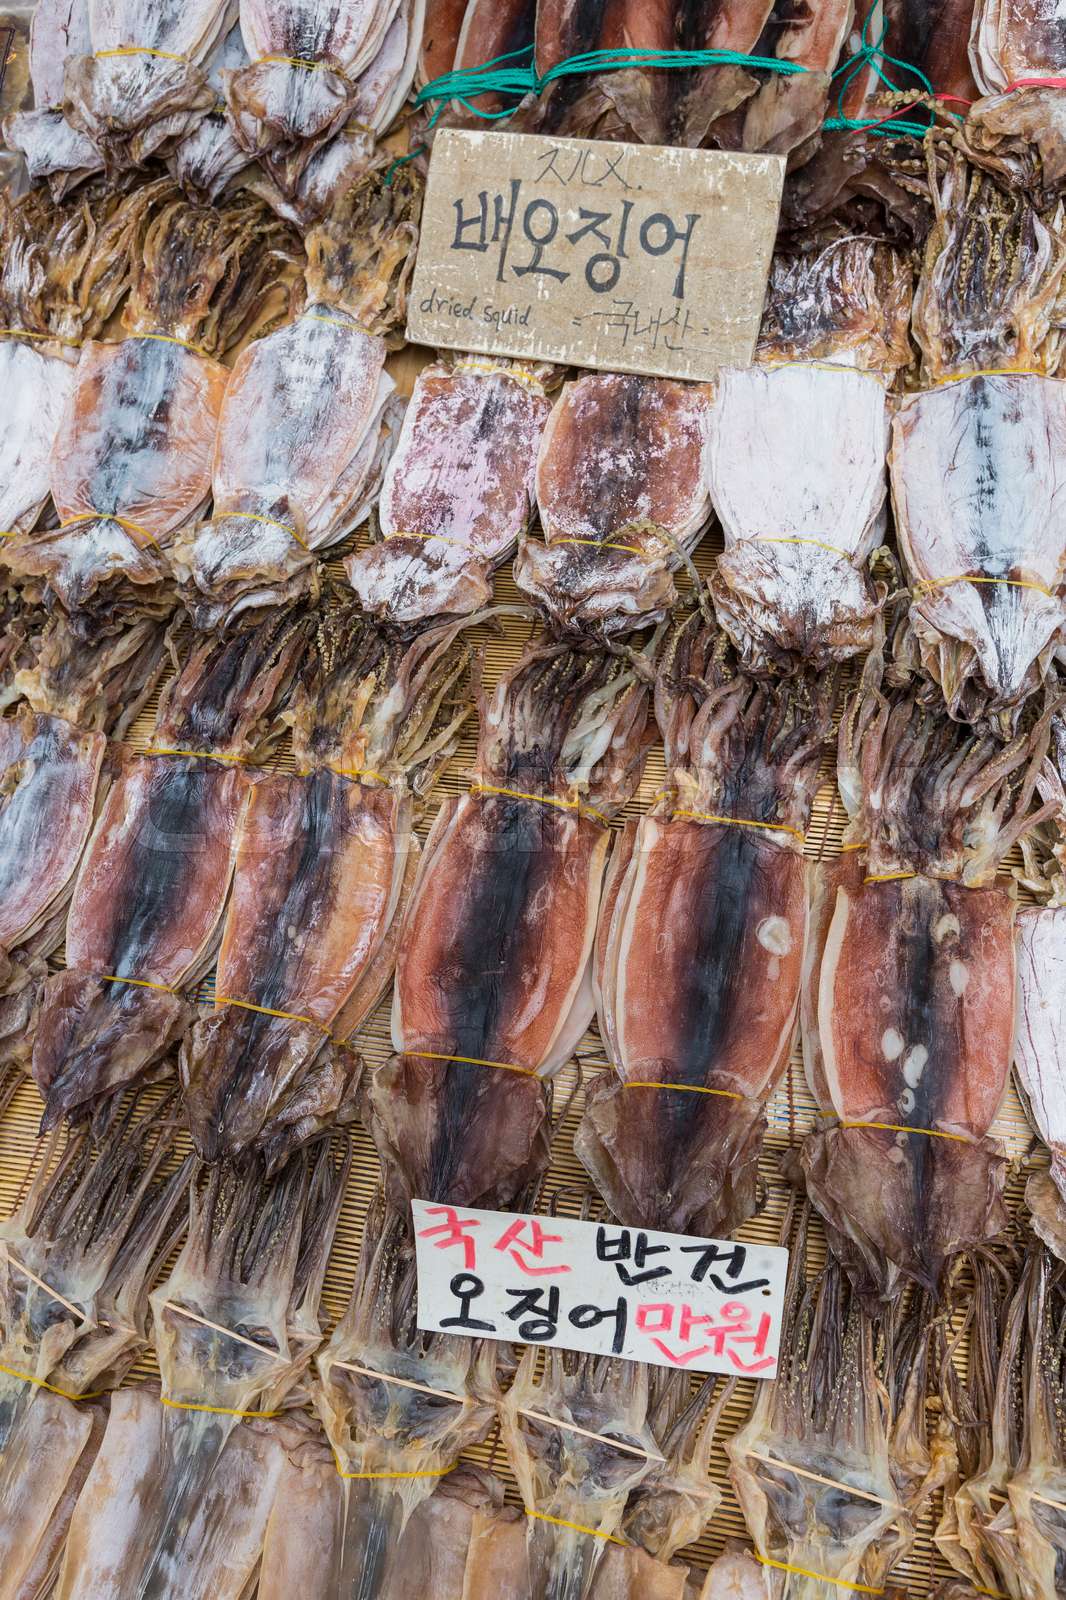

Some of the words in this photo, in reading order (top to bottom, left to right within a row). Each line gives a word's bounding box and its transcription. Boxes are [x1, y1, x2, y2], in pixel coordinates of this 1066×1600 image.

[450, 179, 701, 299] 배오징어
[420, 287, 478, 321] dried
[483, 304, 532, 333] squid
[417, 1206, 572, 1277] 국산
[595, 1225, 771, 1295] 반건
[438, 1272, 628, 1354] 오징어
[635, 1300, 776, 1373] 만원
